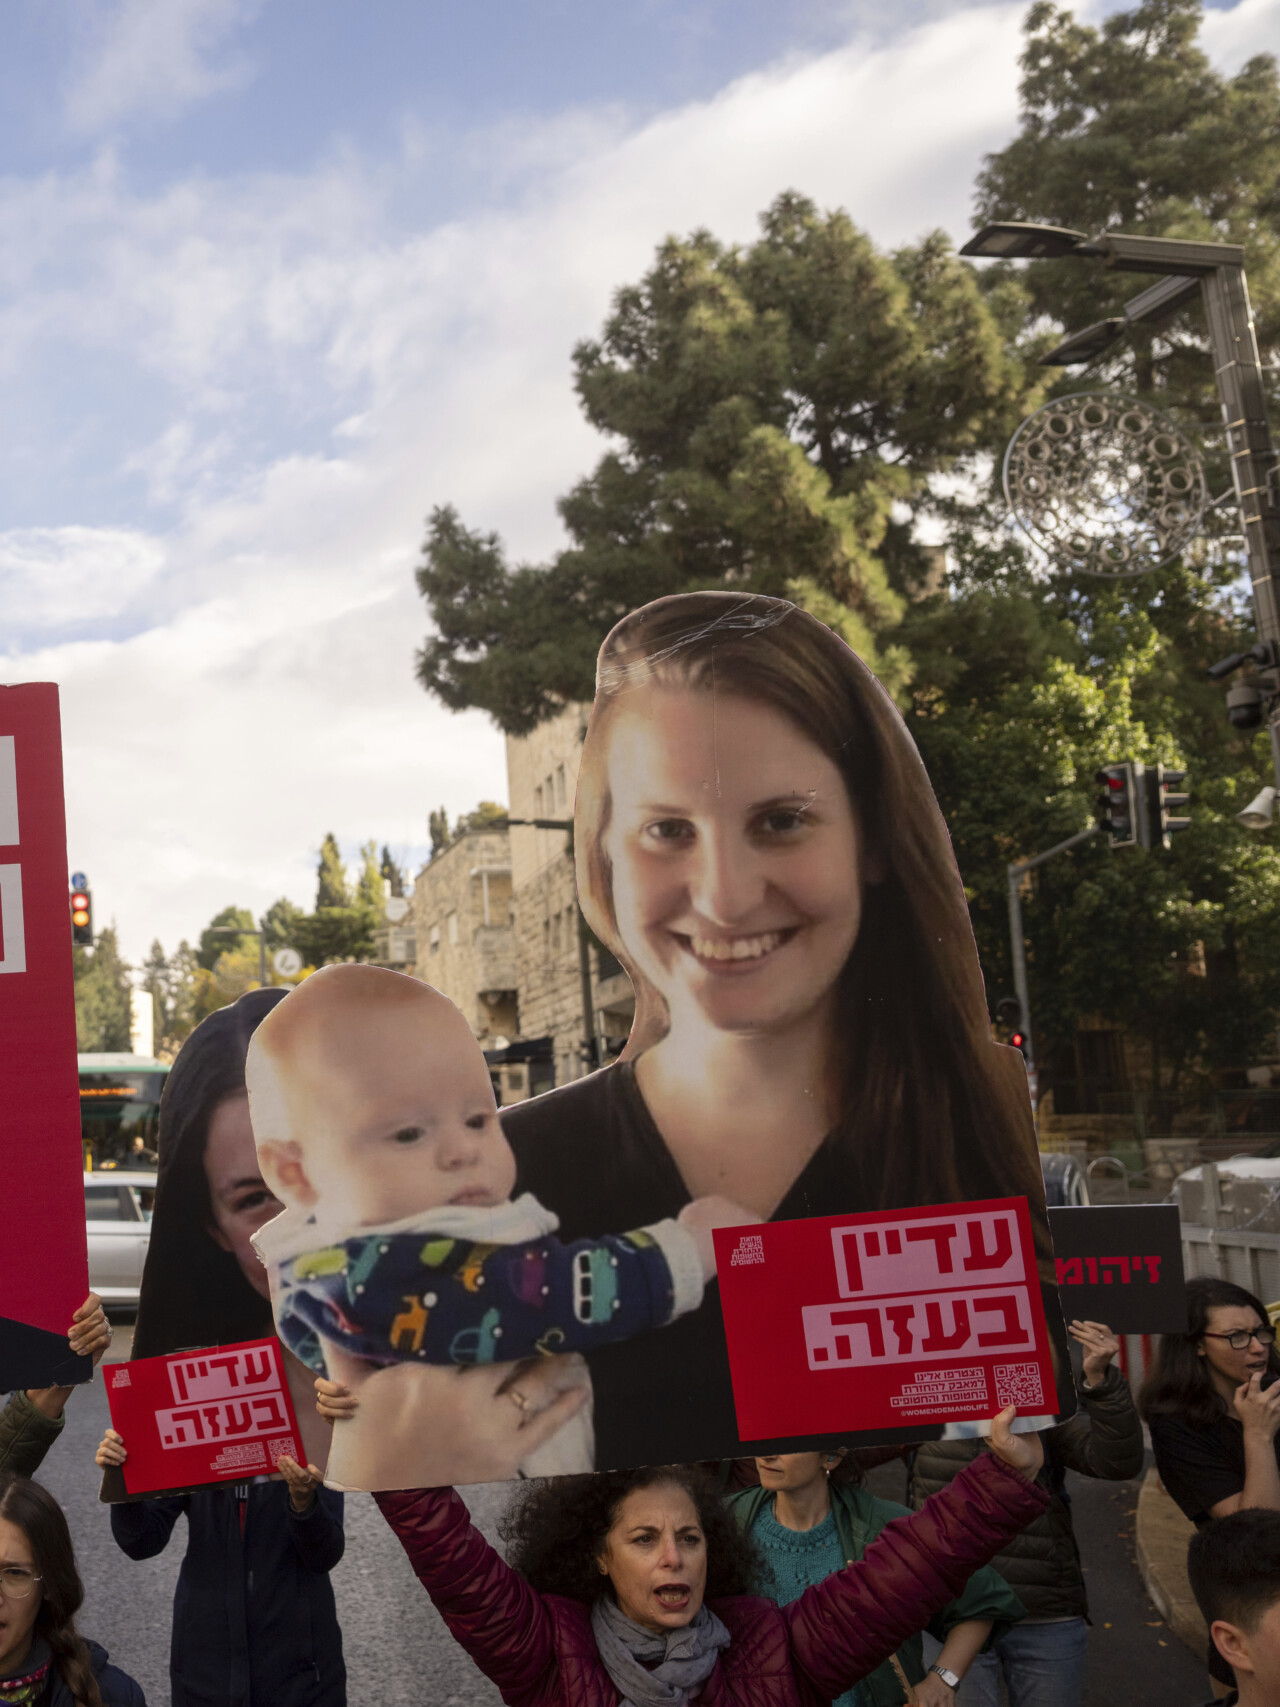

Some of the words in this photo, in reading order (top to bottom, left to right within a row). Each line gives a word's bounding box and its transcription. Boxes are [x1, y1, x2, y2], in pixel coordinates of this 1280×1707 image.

[841, 1217, 1013, 1292] עדיין
[813, 1294, 1030, 1362] בעזה.
[173, 1350, 272, 1401] עדיין
[916, 1372, 941, 1381] אלינו
[949, 1379, 985, 1390] למאבק
[164, 1397, 286, 1444] בעזה.
[901, 1404, 989, 1416] @WOMENDEMANDLIFE
